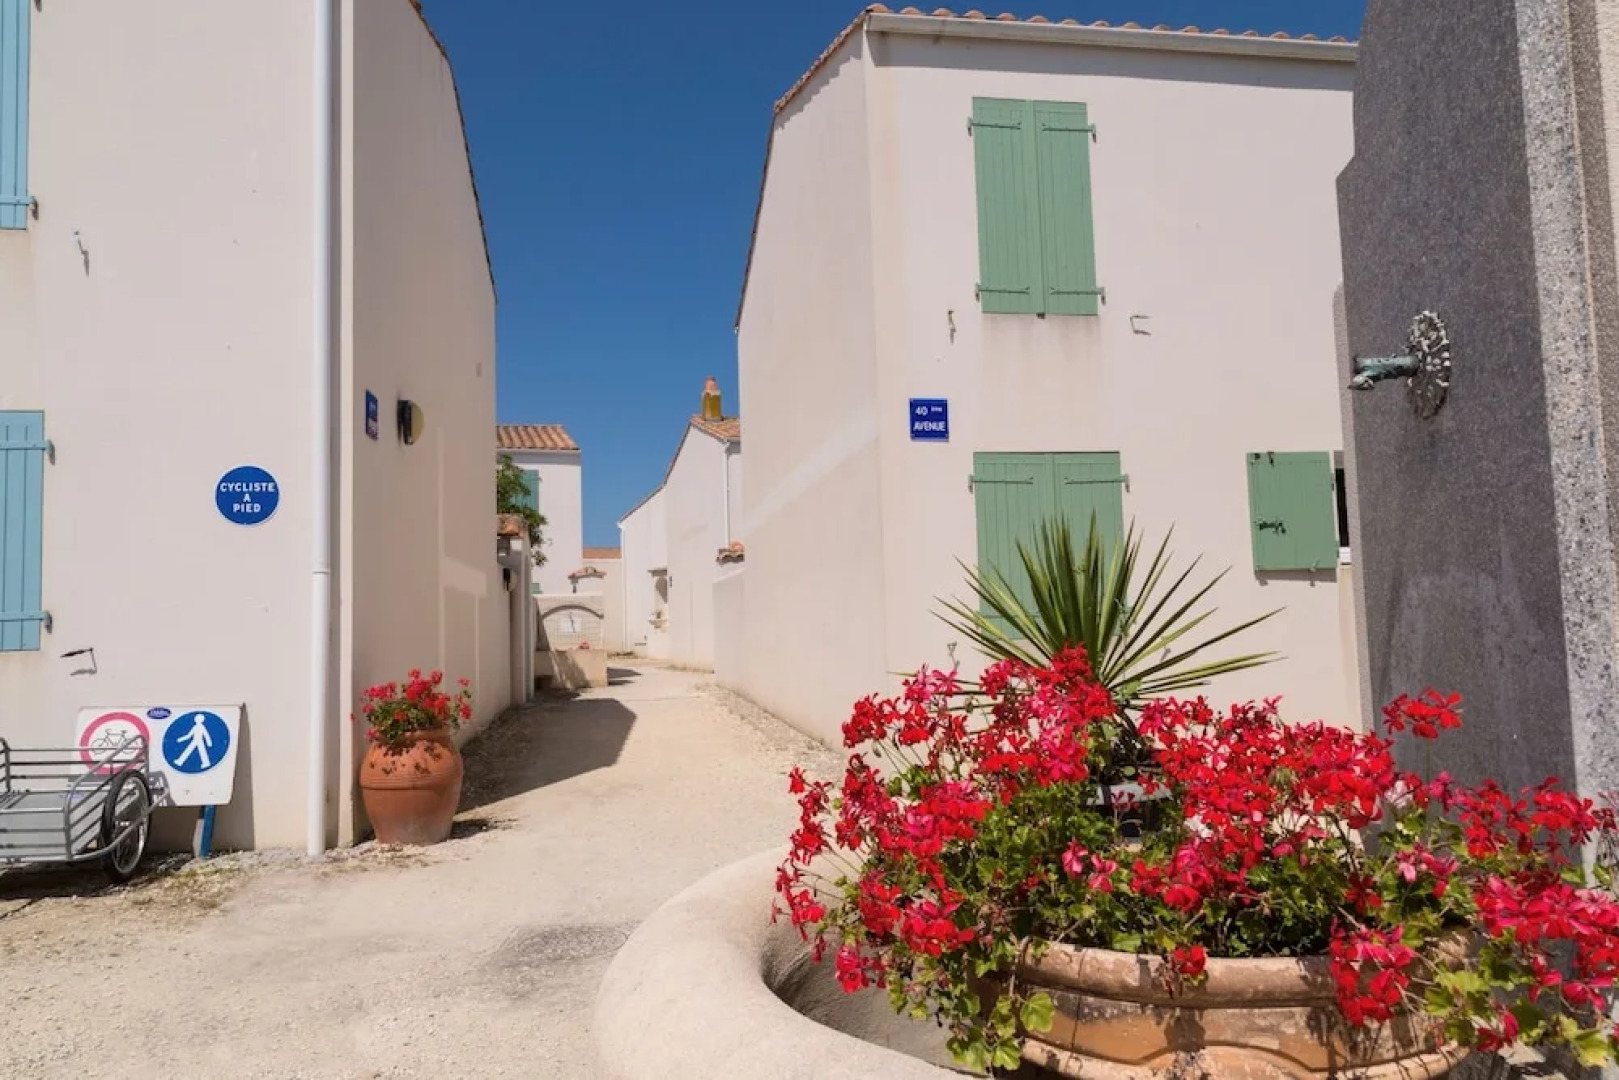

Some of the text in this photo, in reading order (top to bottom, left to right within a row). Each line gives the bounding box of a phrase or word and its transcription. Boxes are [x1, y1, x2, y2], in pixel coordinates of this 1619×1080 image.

[915, 406, 928, 416] 40
[913, 421, 946, 431] AVENUE
[220, 482, 275, 492] CYCLISTE
[243, 493, 251, 502] A
[232, 503, 261, 513] PIED
